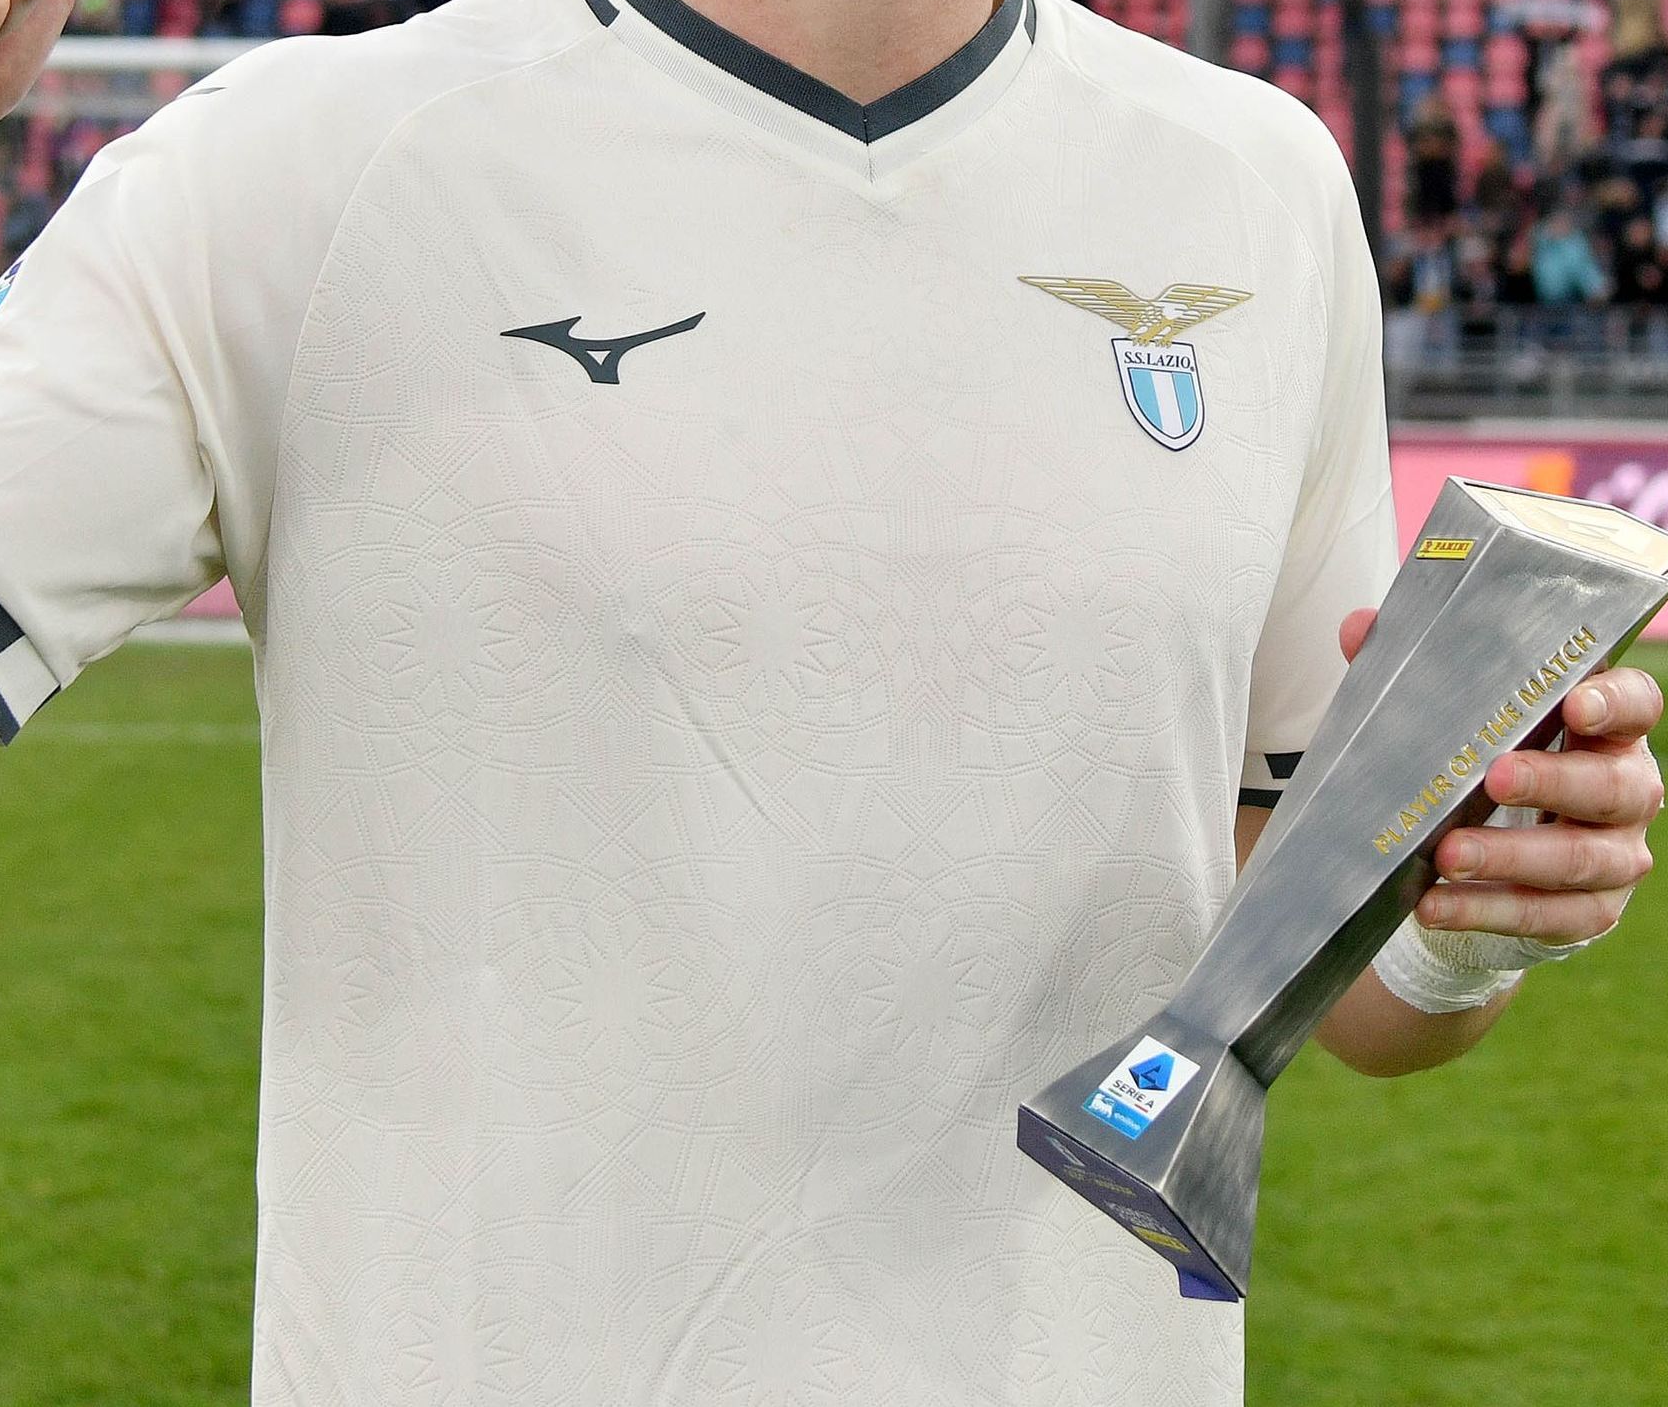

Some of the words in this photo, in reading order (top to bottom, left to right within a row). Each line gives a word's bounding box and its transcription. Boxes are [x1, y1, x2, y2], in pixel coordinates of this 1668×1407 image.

[1373, 773, 1455, 855] PLAYER
[1449, 742, 1481, 778] OF
[1476, 700, 1524, 747] THE
[1515, 625, 1598, 709] MATCH
[1112, 1079, 1146, 1103] SERIE
[1145, 1100, 1155, 1109] A
